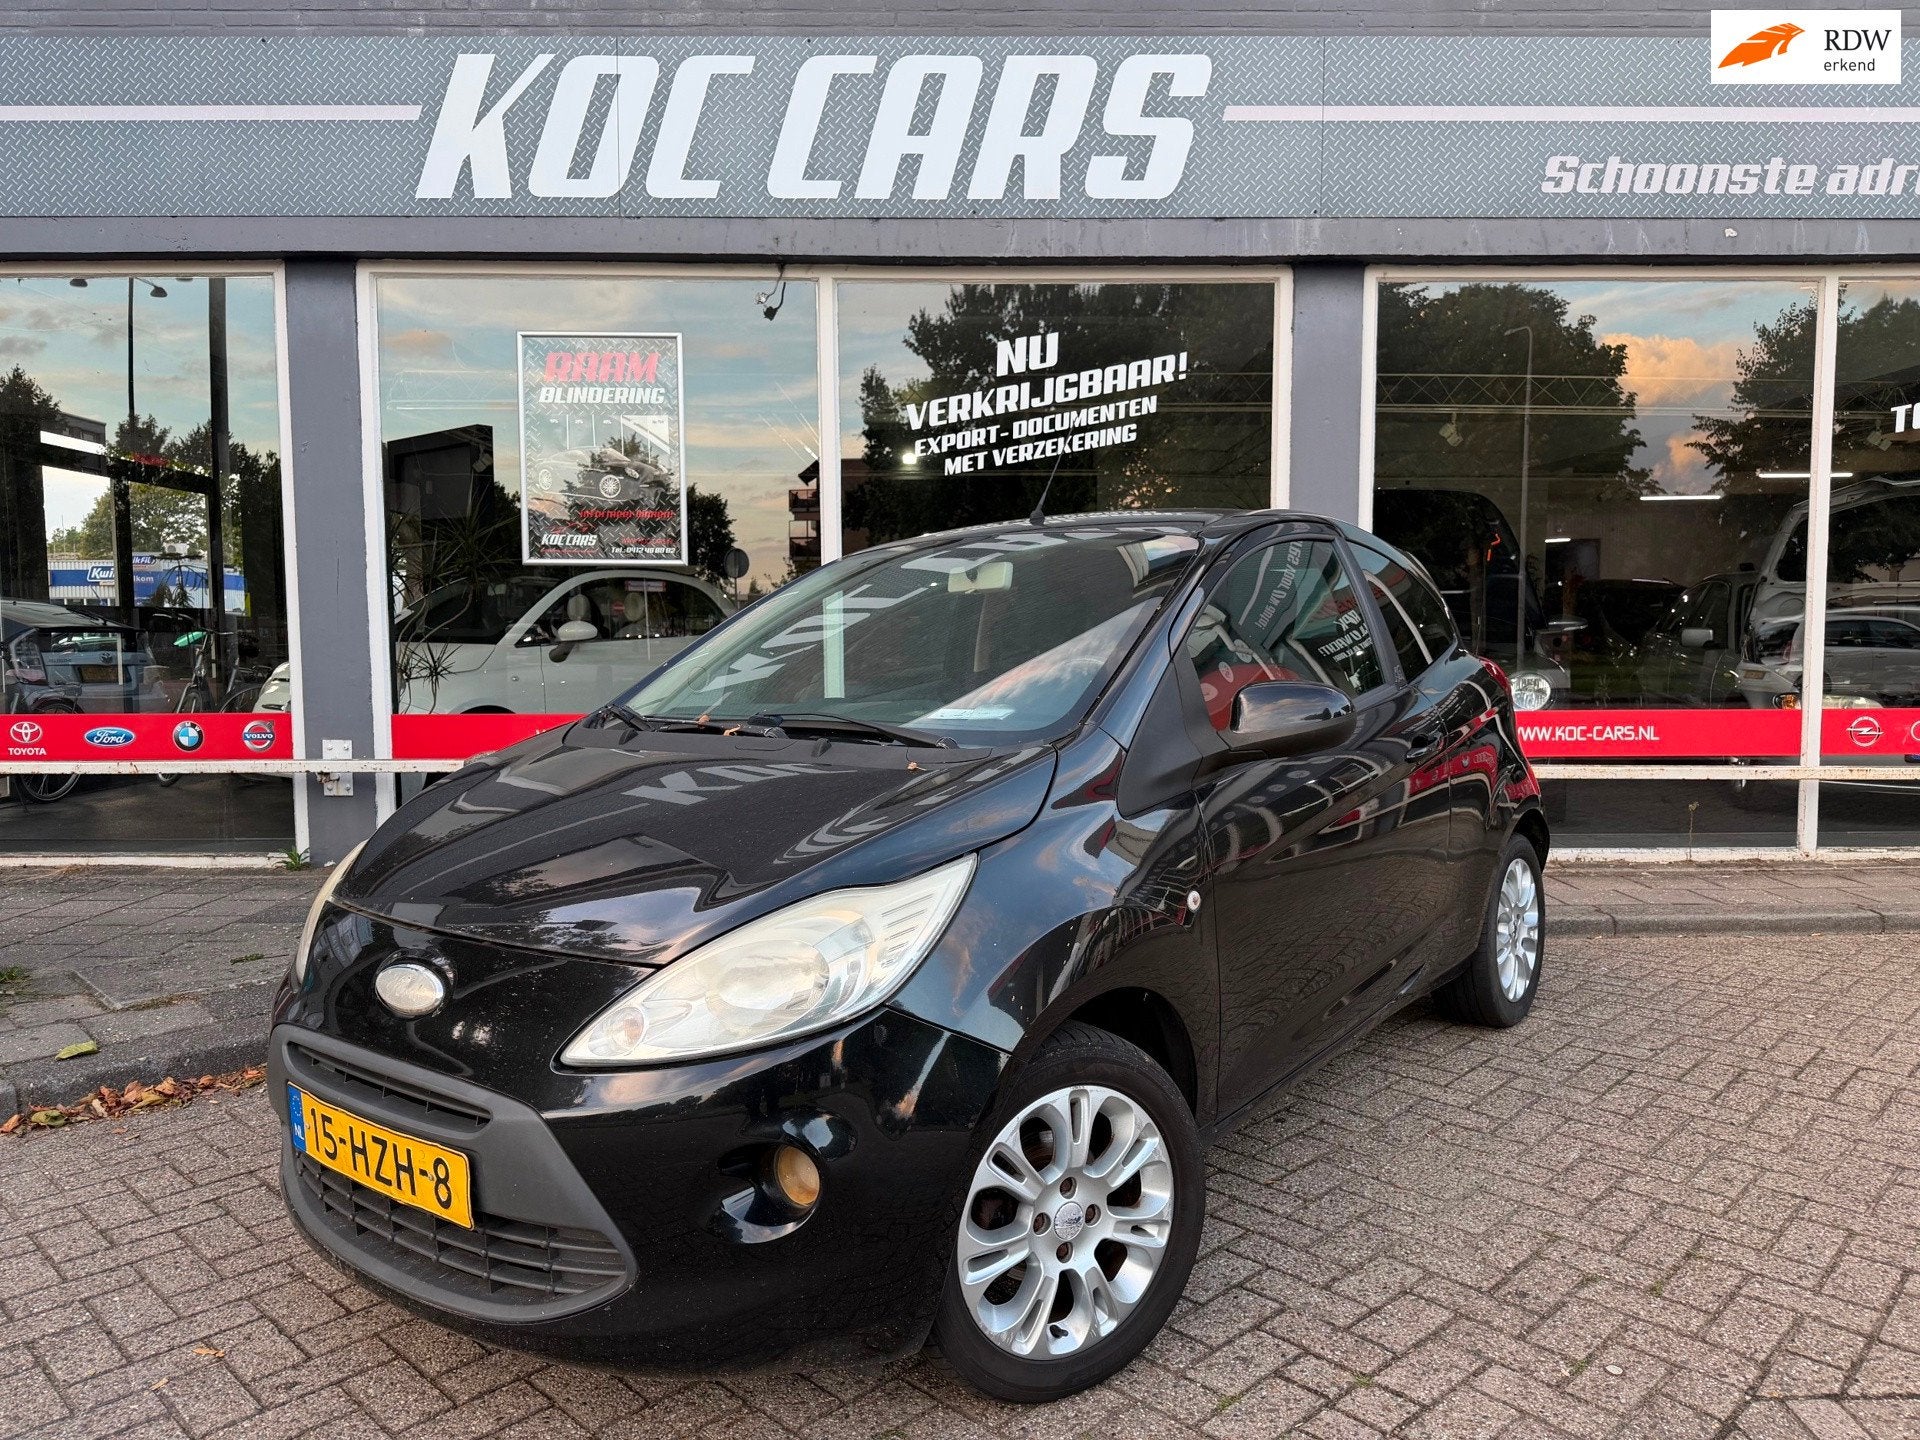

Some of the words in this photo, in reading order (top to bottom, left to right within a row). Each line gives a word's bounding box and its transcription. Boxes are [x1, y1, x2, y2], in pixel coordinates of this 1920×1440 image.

[415, 53, 756, 199] KOC
[767, 53, 1213, 200] CARS
[1541, 155, 1818, 195] Schoonste
[1825, 157, 1920, 196] adr
[543, 351, 661, 384] RAAM
[996, 331, 1060, 378] NU
[538, 386, 667, 405] BLINDERING
[906, 351, 1188, 431] VERKRIJGBAAR!
[1012, 395, 1158, 440] DOCUMENTEN
[944, 451, 989, 476] MET
[992, 423, 1138, 468] VERZEKERING
[541, 533, 568, 546] KOC
[566, 533, 598, 546] CARS
[91, 567, 115, 579] Kwi
[7, 747, 47, 756] TOYOTA
[94, 730, 126, 744] Ford
[244, 732, 274, 740] VOLVO
[293, 1123, 305, 1141] NL
[311, 1108, 453, 1210] 15-HZH-8
